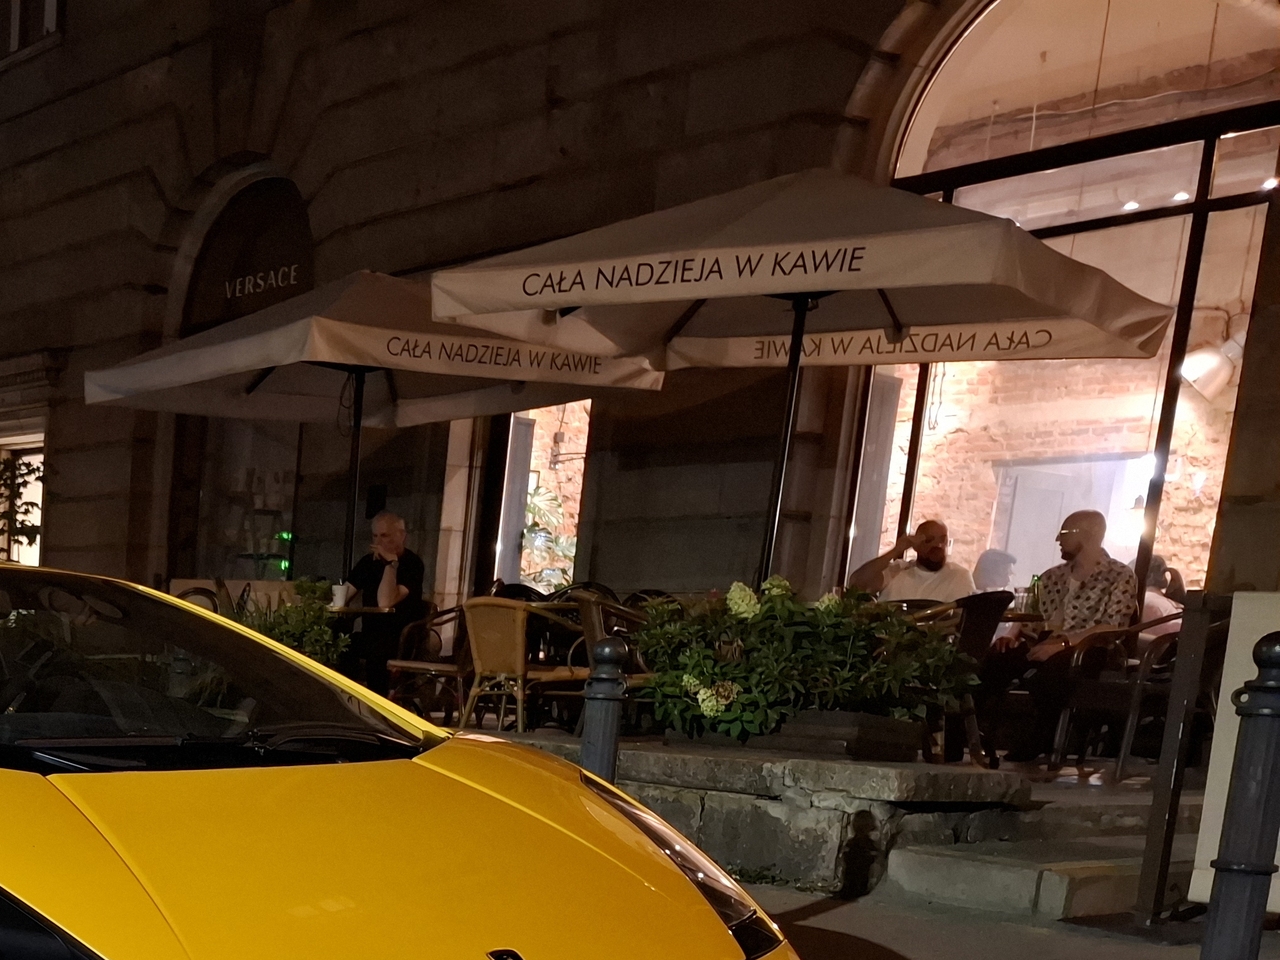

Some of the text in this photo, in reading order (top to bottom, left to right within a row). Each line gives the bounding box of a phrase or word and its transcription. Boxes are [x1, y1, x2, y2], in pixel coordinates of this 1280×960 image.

[225, 264, 299, 299] VERSACE
[522, 247, 866, 296] CAŁA NADZIEJA W KAWIE
[386, 336, 603, 375] CAŁA NADZIEJA W KAWIE
